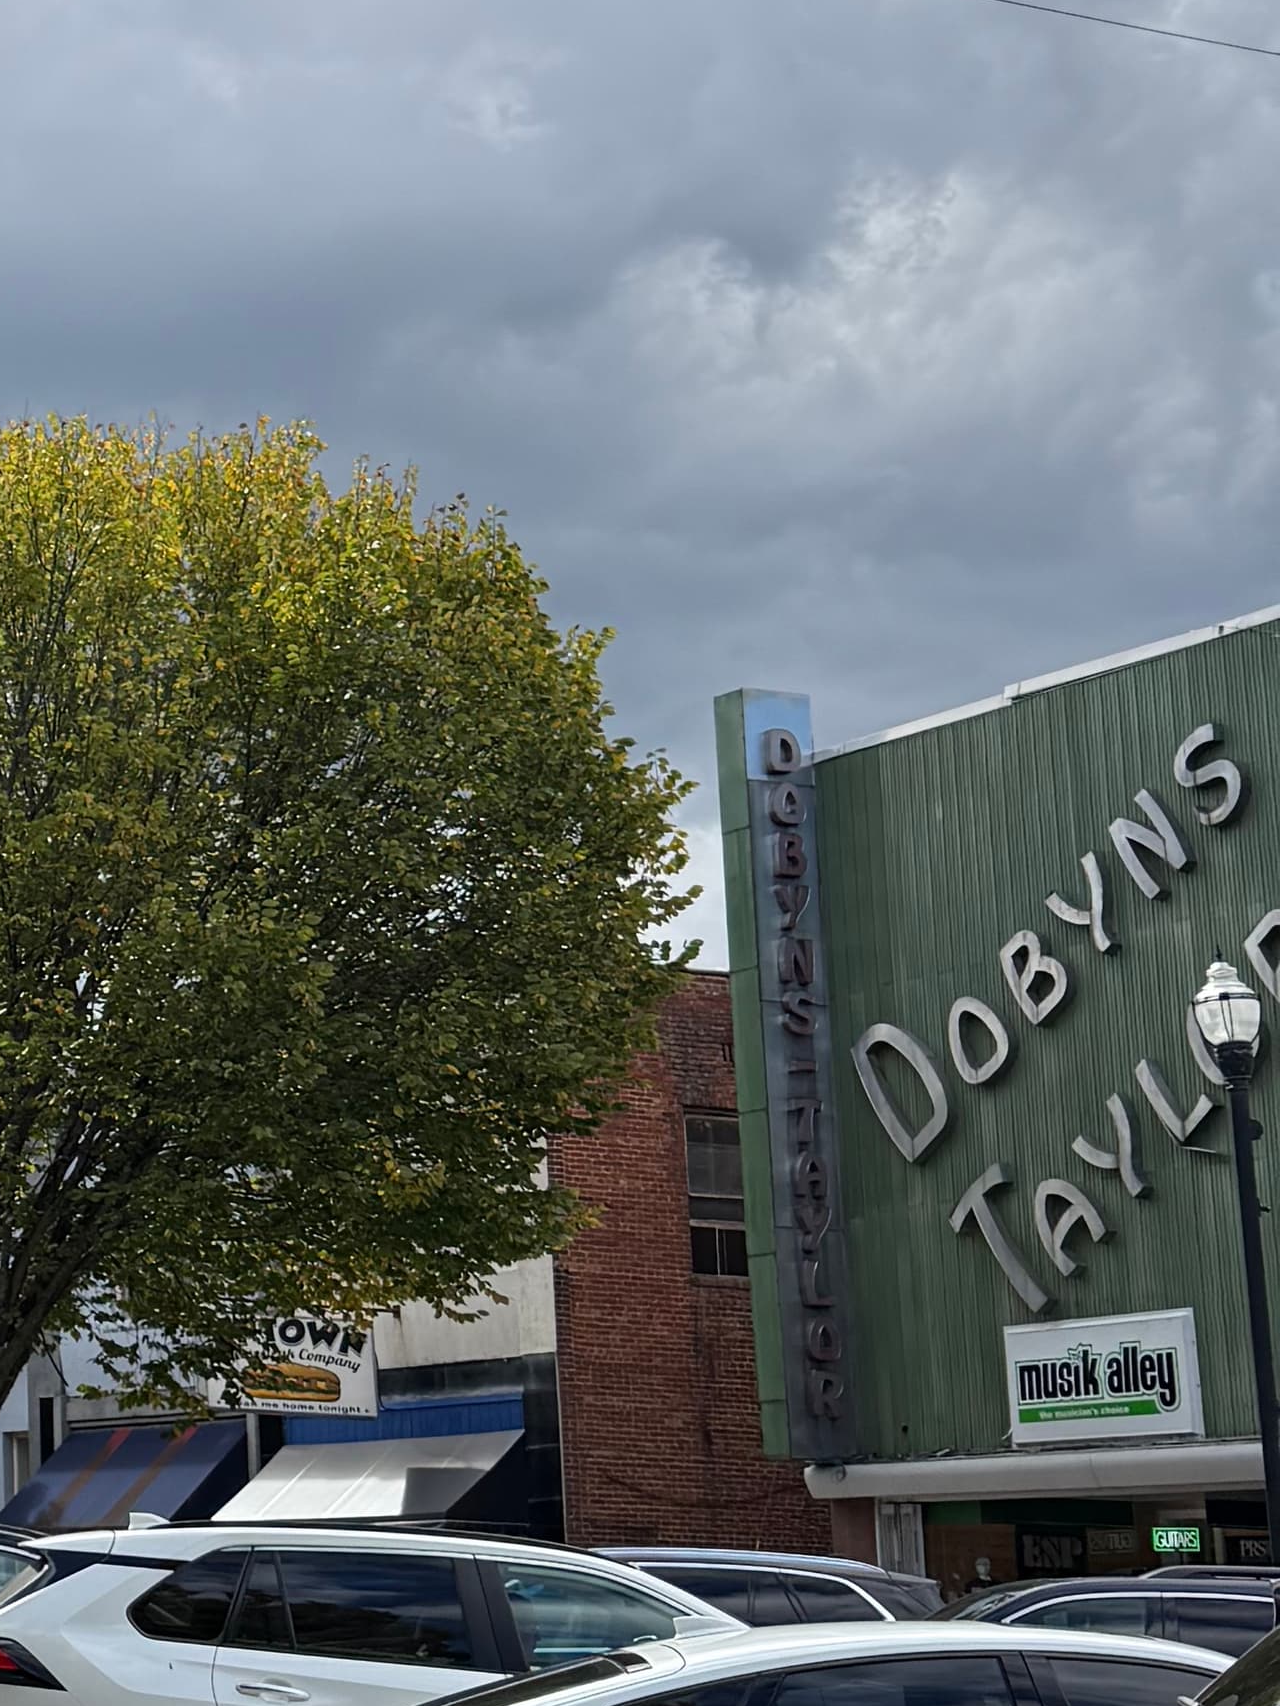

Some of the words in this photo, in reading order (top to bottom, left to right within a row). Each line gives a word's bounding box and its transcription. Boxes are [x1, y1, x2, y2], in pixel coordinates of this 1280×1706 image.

[851, 723, 1242, 1163] DOBYNS
[298, 1348, 361, 1374] Company
[1018, 1349, 1099, 1401] musik
[1106, 1345, 1177, 1408] alley
[319, 1404, 361, 1414] tonight
[1156, 1530, 1197, 1548] GUITARS
[1240, 1539, 1266, 1558] PRS
